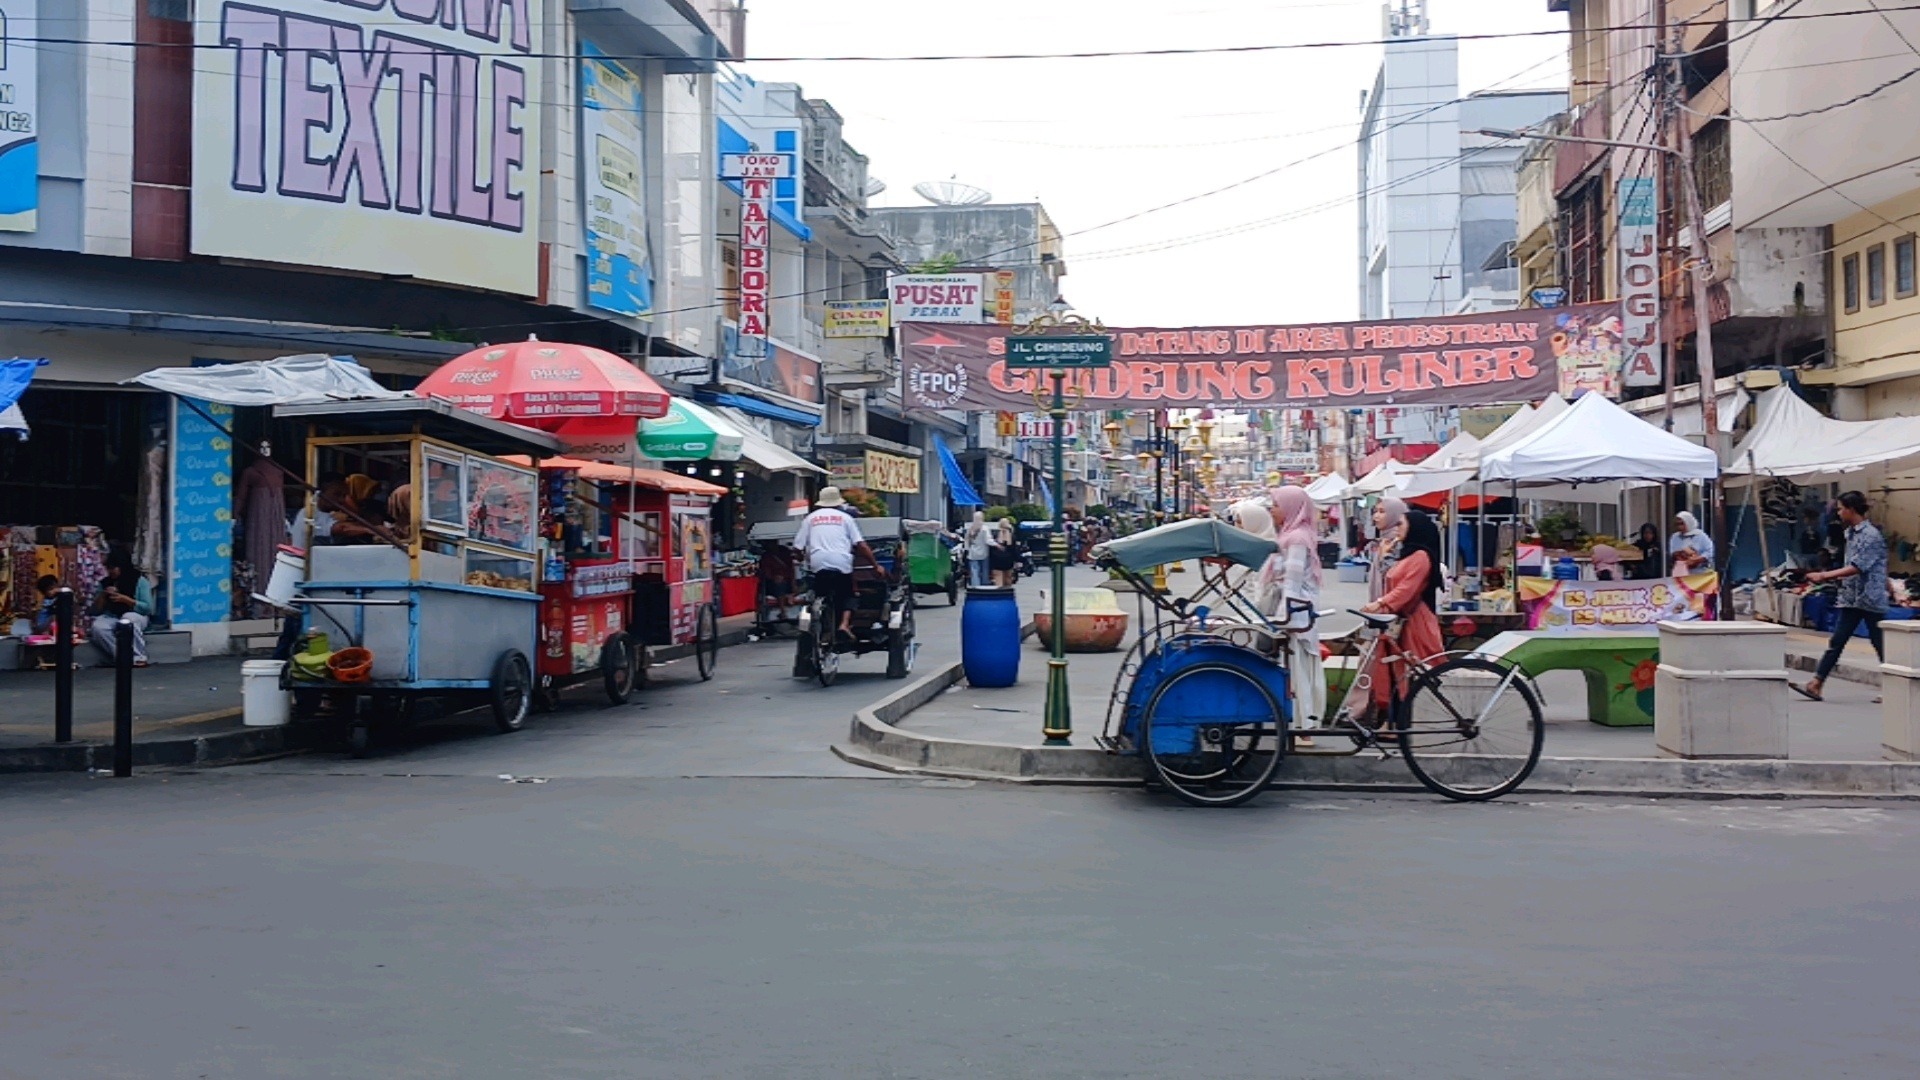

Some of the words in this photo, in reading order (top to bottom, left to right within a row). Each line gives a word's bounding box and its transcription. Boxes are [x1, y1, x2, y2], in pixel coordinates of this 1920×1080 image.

[221, 1, 525, 232] TEXTILE
[737, 155, 780, 165] TOKO
[741, 167, 776, 176] JAM
[742, 180, 769, 335] TAMBORA
[895, 285, 978, 305] PUSAT
[1625, 234, 1657, 376] JOGJA
[1034, 342, 1104, 353] CIHIDEUNG
[1120, 331, 1231, 355] DATANG
[1235, 329, 1266, 353] DI
[1270, 326, 1349, 352] AREA
[1353, 323, 1540, 350] PEDESTRIAN
[920, 372, 957, 393] FPC
[1286, 346, 1540, 399] KULINER
